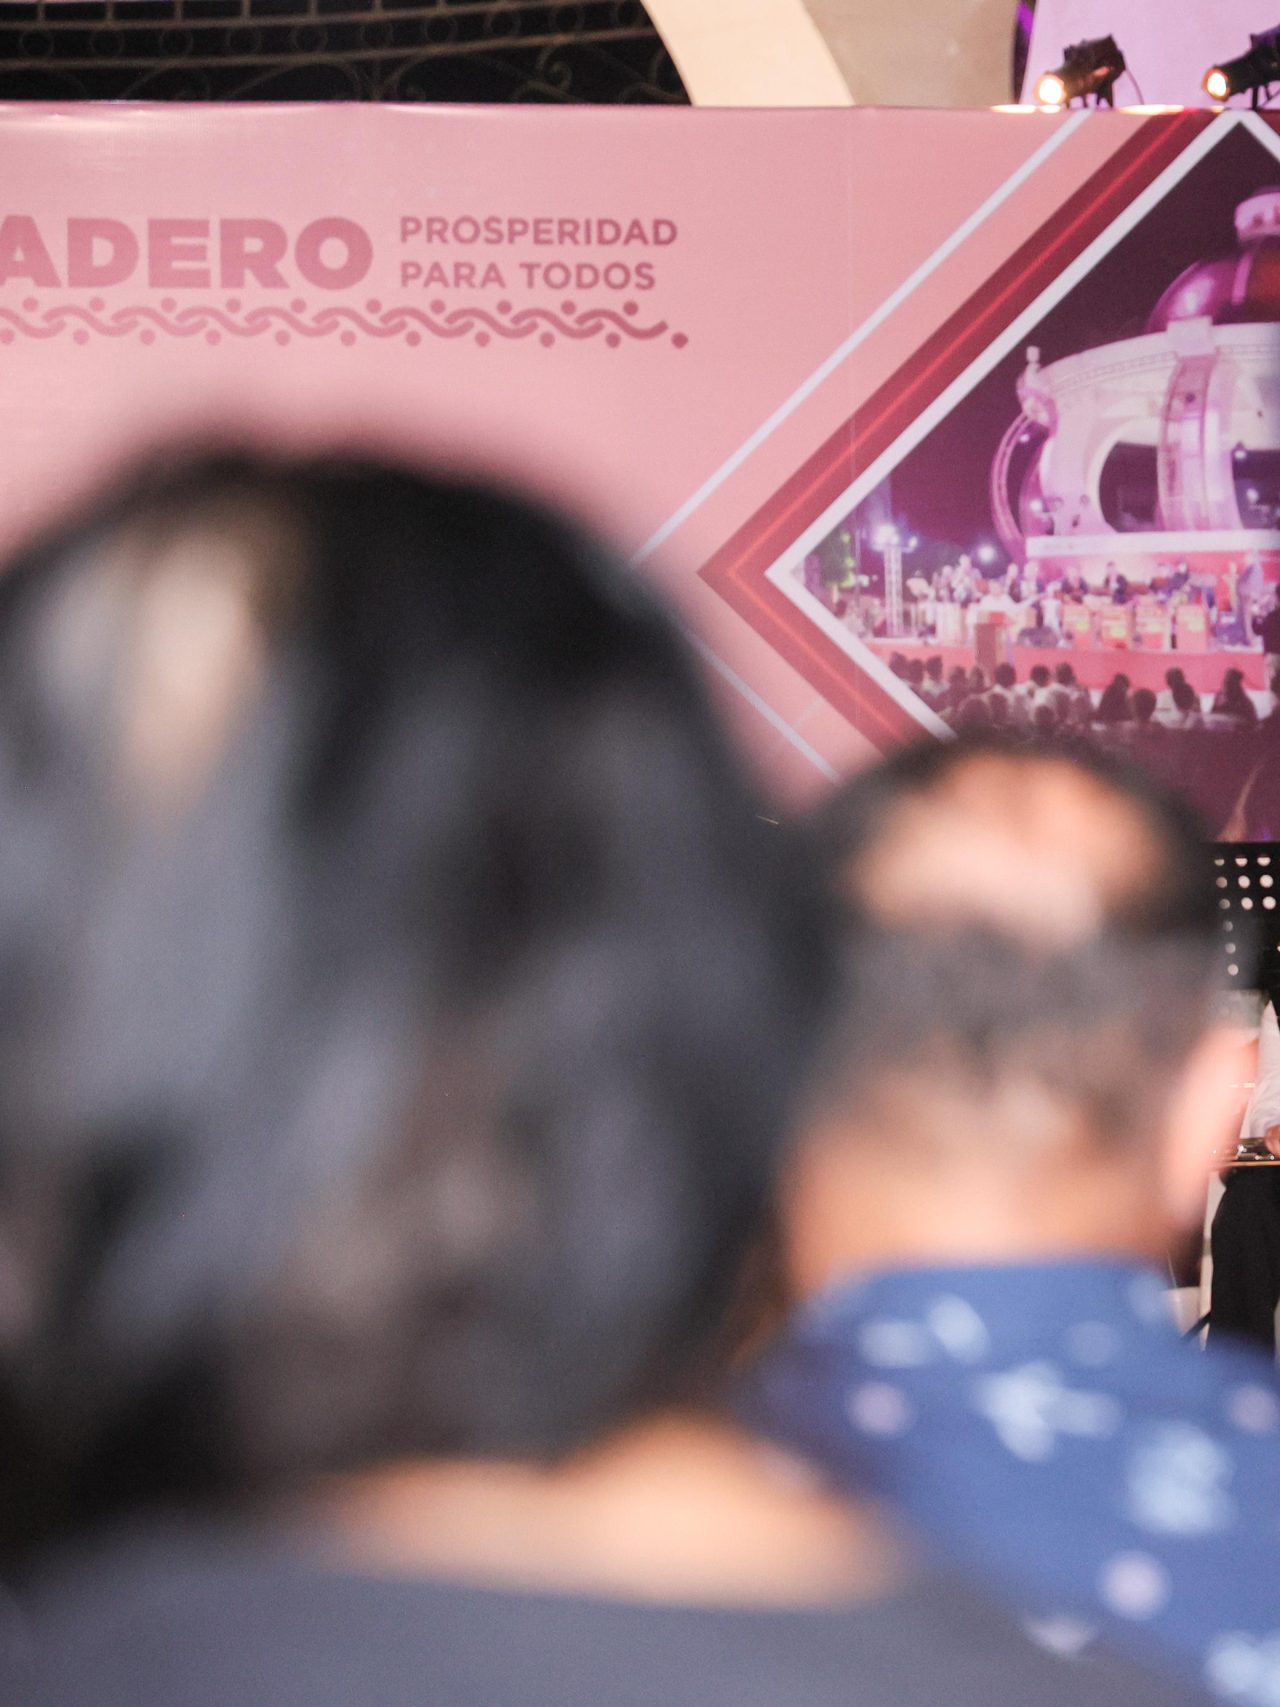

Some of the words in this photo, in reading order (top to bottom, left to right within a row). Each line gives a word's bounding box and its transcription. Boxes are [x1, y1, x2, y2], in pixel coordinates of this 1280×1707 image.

[401, 215, 678, 246] PROSPERIDAD
[401, 261, 506, 289] PARA
[519, 261, 655, 290] TODOS
